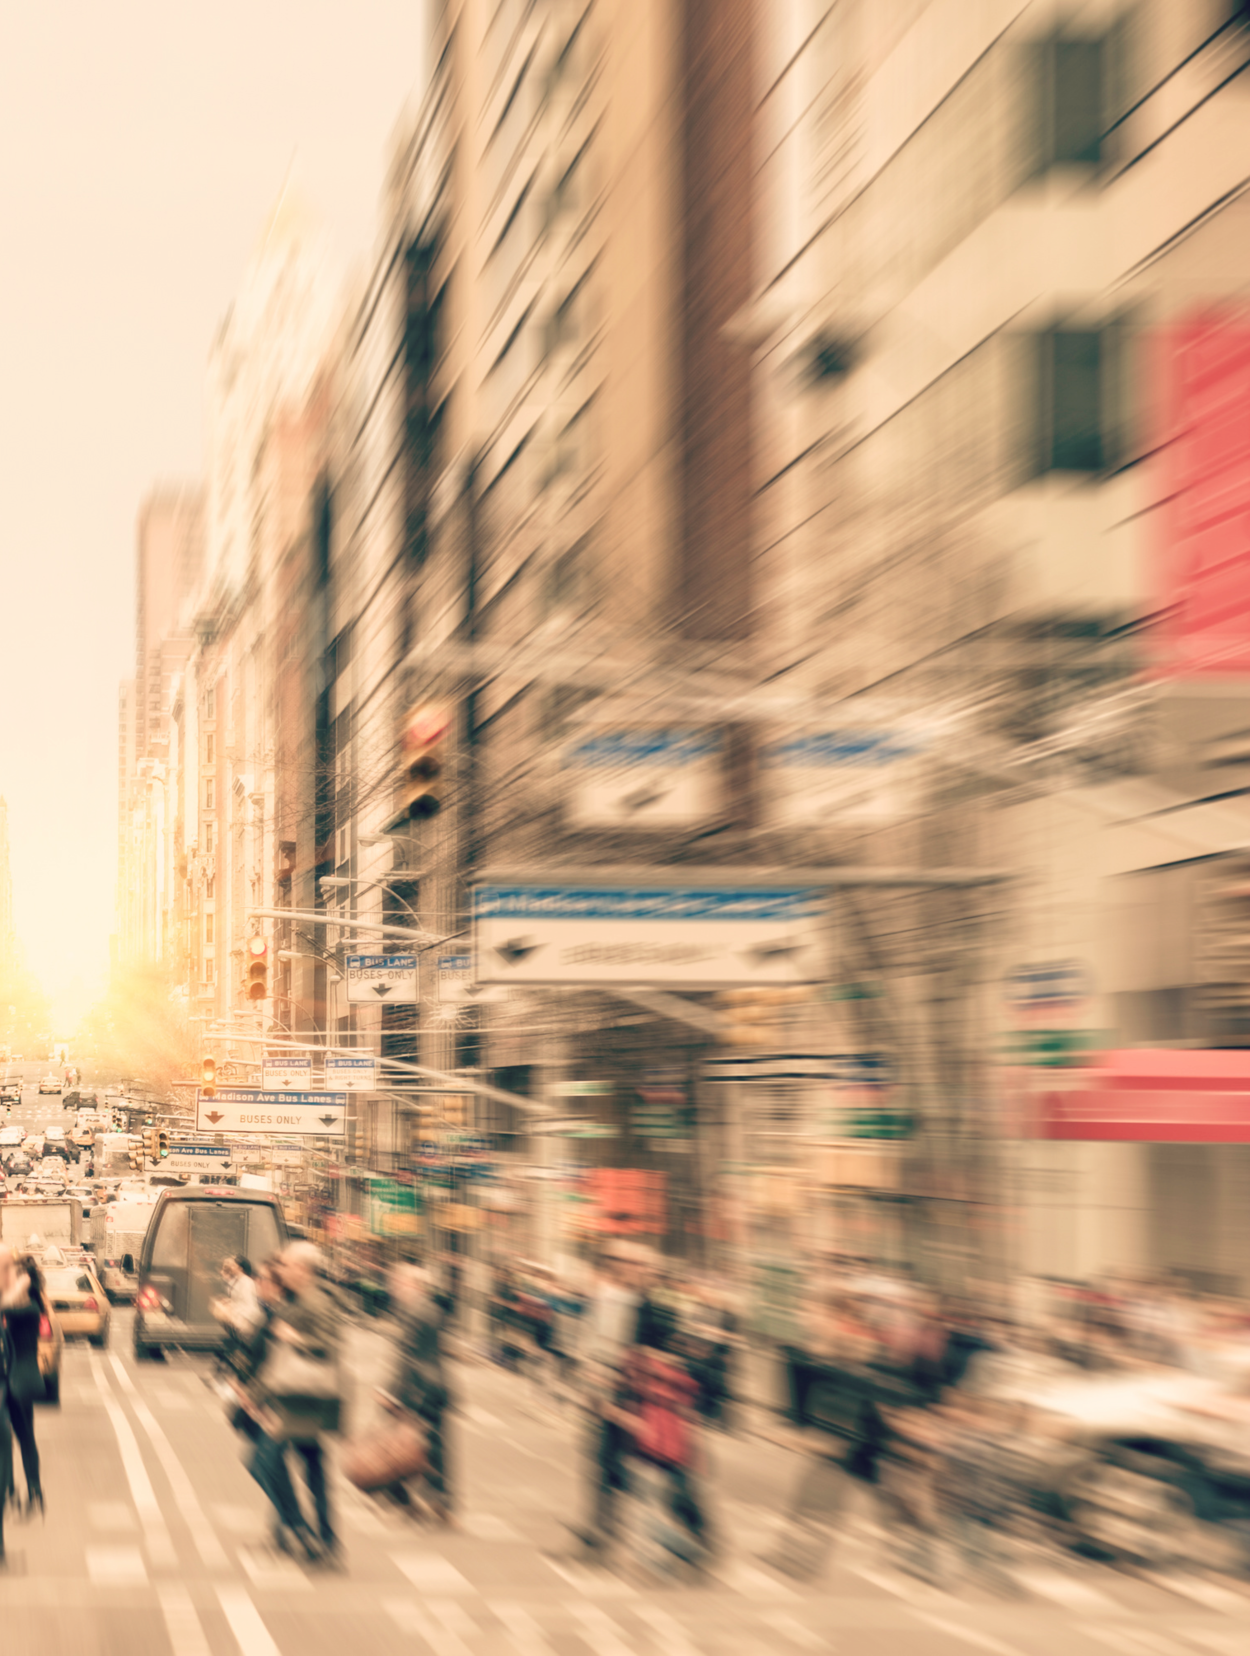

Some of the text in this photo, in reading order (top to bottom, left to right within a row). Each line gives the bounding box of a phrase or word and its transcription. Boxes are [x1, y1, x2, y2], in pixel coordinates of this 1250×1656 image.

[365, 958, 414, 967] BUS LANE
[456, 959, 469, 967] BU
[349, 970, 414, 980] BUSES ONLY
[212, 1092, 331, 1103] Madison Ave Bus Lanes
[240, 1114, 302, 1125] BUSES ONLY
